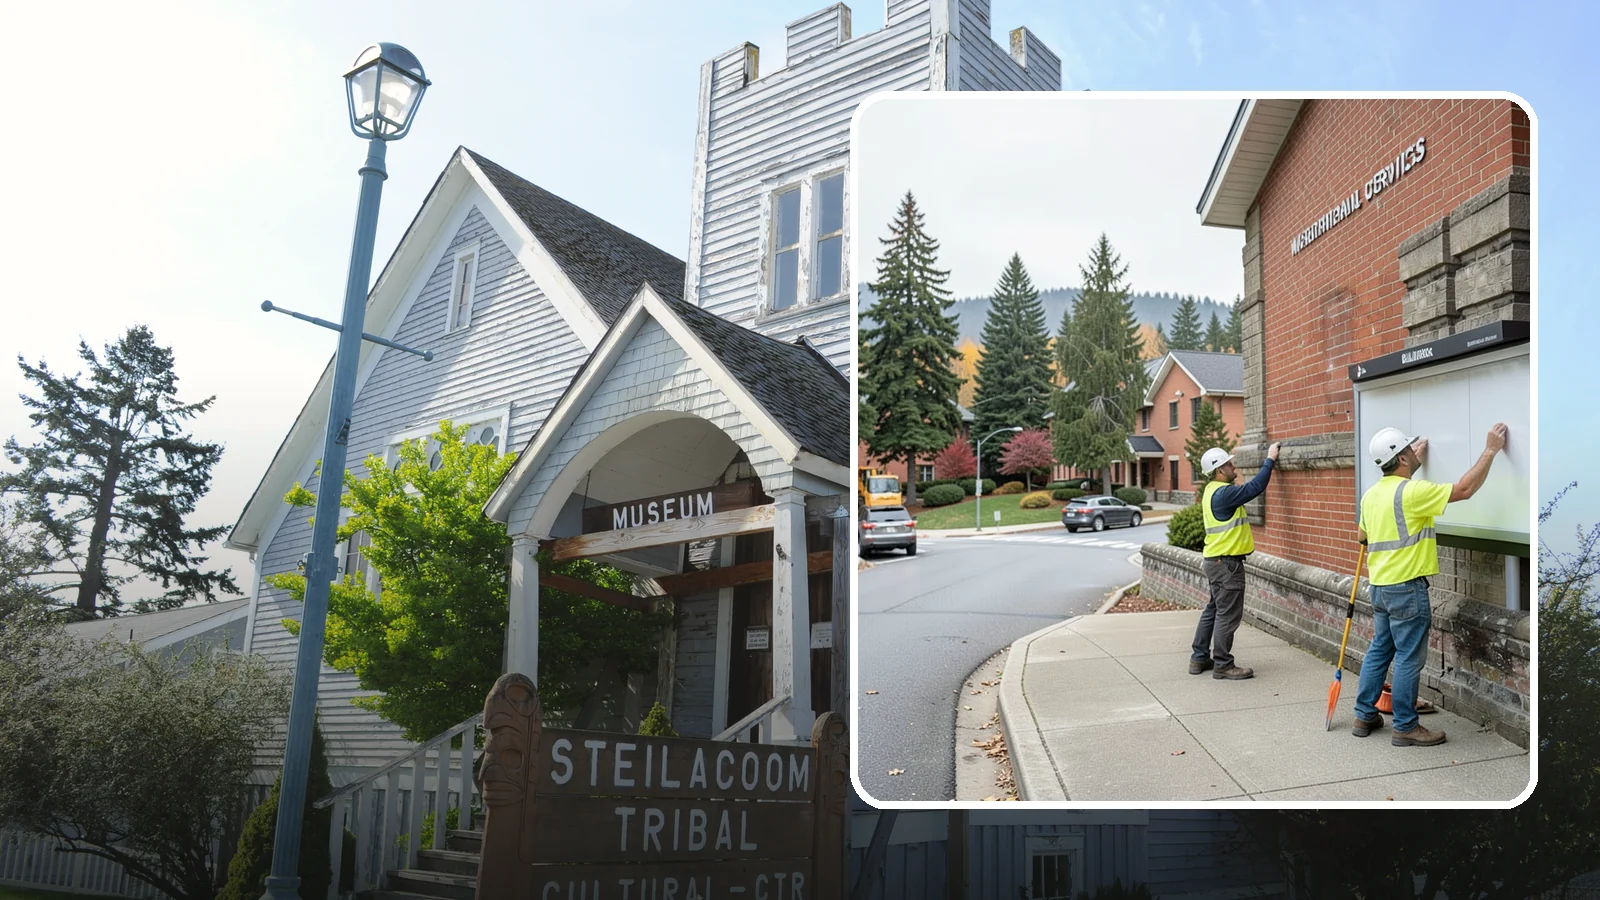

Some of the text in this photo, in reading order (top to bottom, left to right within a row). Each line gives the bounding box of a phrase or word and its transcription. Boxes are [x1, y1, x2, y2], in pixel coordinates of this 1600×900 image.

[612, 492, 714, 530] MUSEUM
[550, 738, 810, 792] STEILACOOM
[615, 806, 757, 852] TRIBAL
